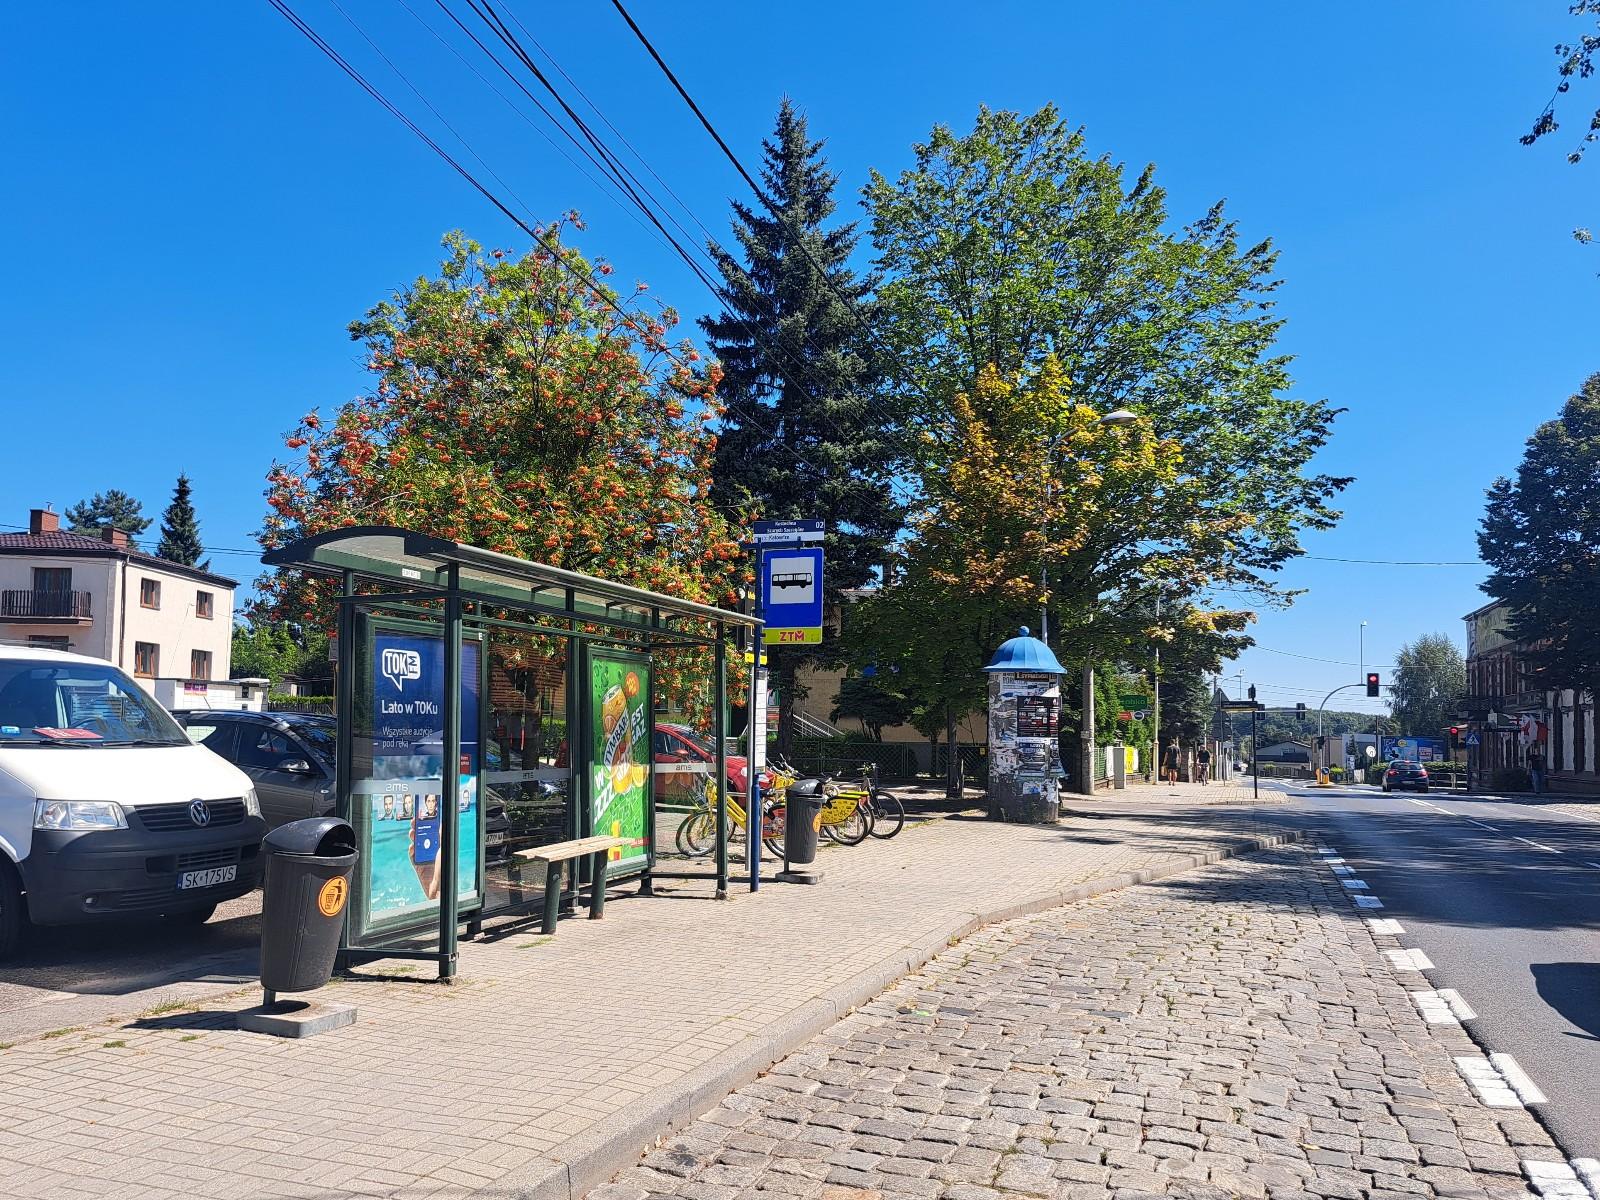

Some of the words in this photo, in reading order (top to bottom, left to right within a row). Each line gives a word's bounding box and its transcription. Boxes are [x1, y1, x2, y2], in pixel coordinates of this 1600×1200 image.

[815, 521, 824, 529] 02
[779, 630, 805, 642] ZTM
[385, 652, 408, 675] TOK
[408, 655, 418, 674] FM
[381, 699, 404, 714] Lato
[404, 703, 414, 714] w
[414, 700, 438, 715] TOKu
[185, 872, 199, 888] SK
[205, 866, 234, 885] 175VS
